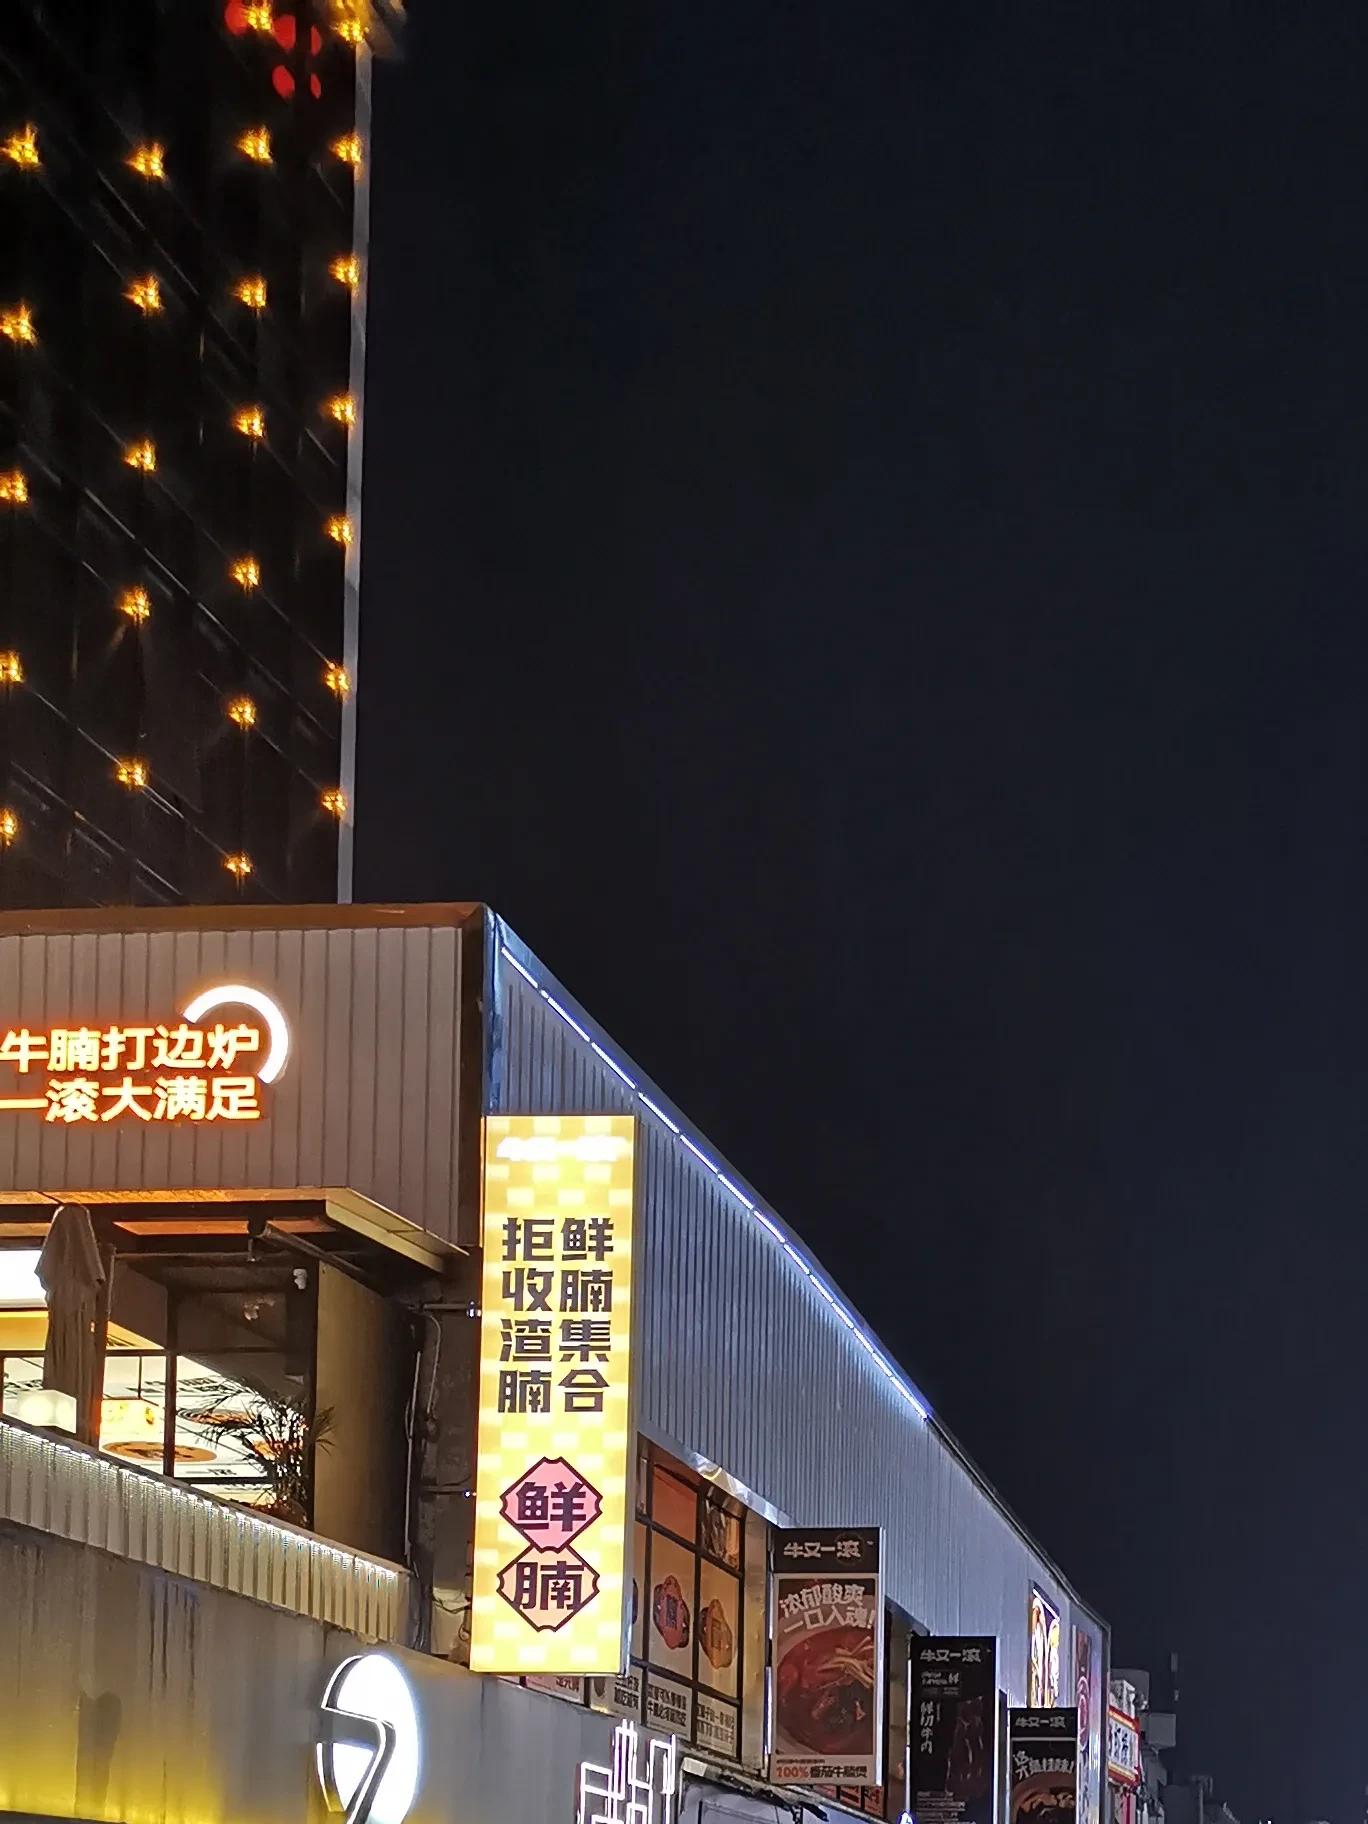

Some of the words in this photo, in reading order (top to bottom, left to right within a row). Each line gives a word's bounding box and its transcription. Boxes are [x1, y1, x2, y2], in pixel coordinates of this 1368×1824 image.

[0, 1022, 261, 1074] 牛腩打边炉
[0, 1074, 262, 1124] 一滚大满足
